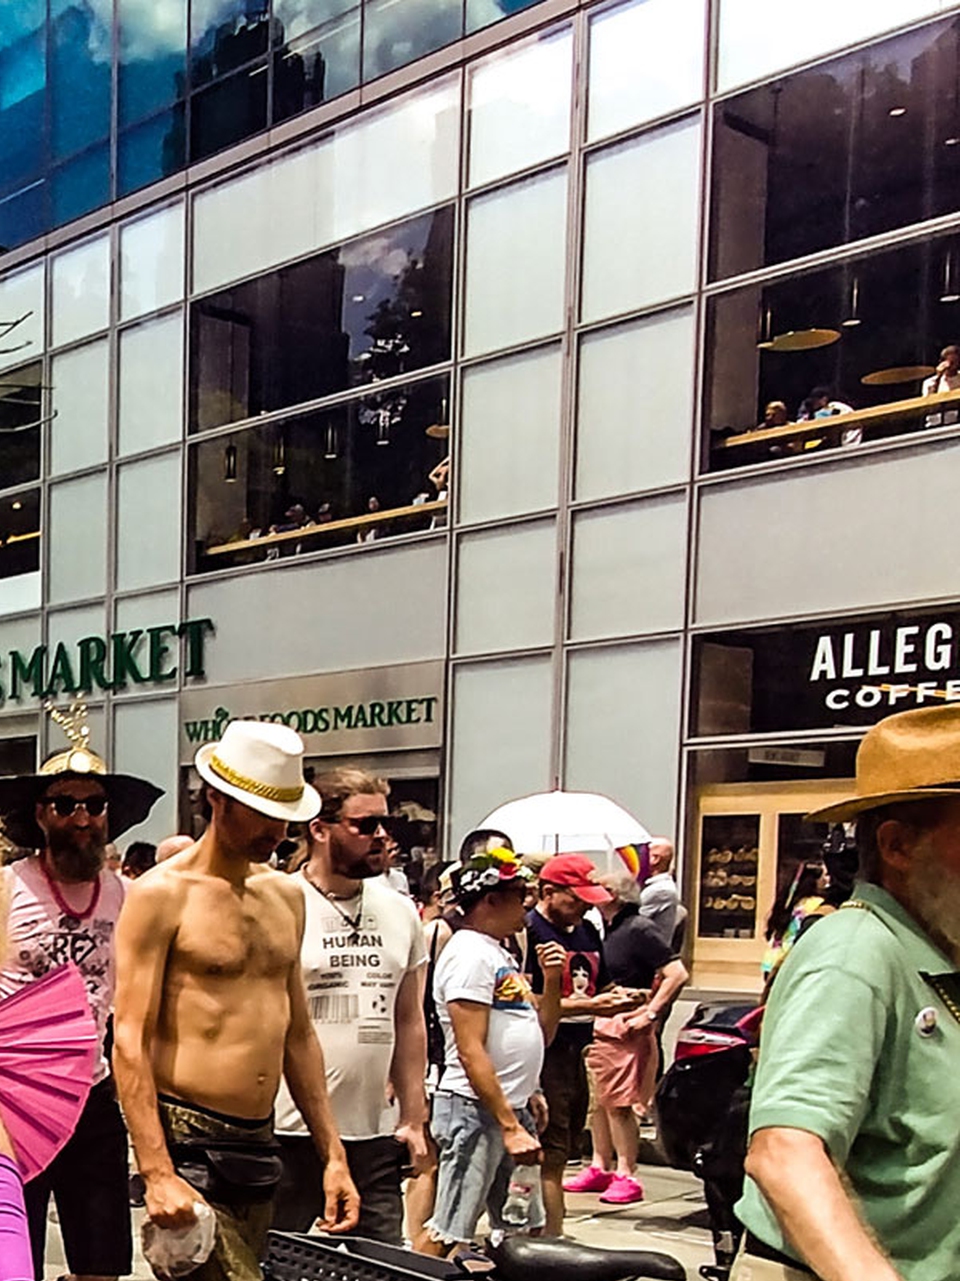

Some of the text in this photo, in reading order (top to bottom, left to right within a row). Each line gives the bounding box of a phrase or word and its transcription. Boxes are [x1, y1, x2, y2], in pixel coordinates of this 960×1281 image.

[8, 618, 216, 700] MARKET
[810, 622, 953, 681] ALLEG
[825, 680, 960, 710] COFFE
[334, 697, 438, 730] MARKET
[329, 954, 381, 968] BEING
